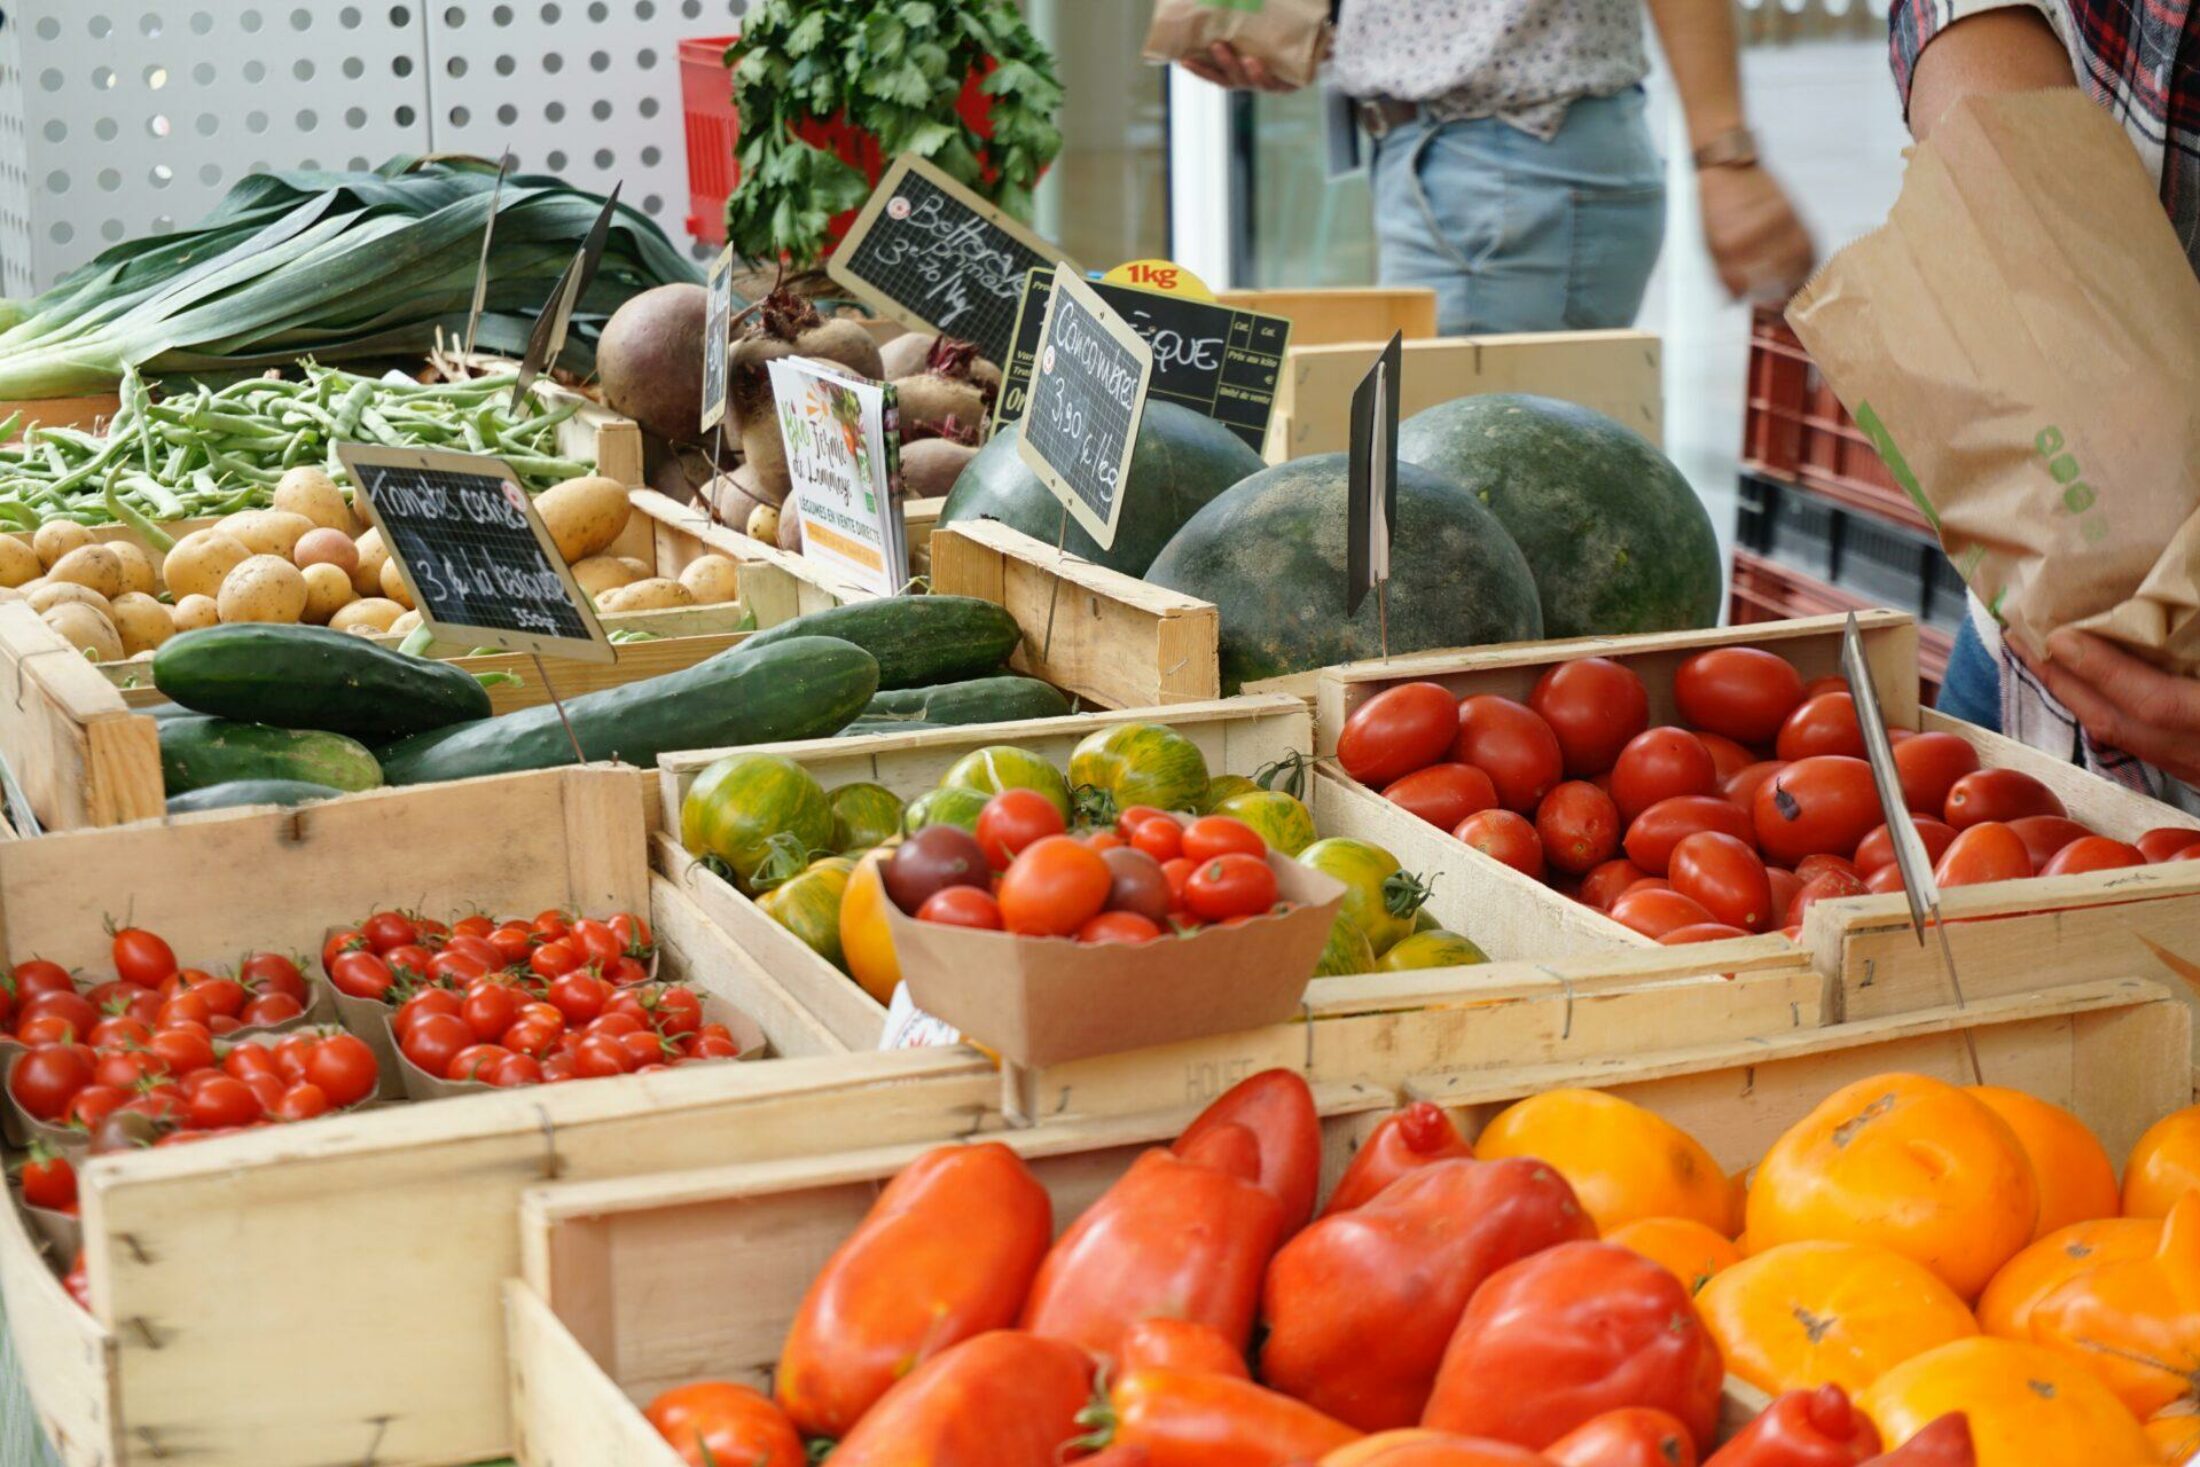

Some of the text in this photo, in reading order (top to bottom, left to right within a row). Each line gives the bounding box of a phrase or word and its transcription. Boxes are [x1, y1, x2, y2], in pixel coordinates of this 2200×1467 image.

[1127, 265, 1179, 289] 1kg
[371, 470, 462, 521] Tomates
[417, 560, 448, 602] 3
